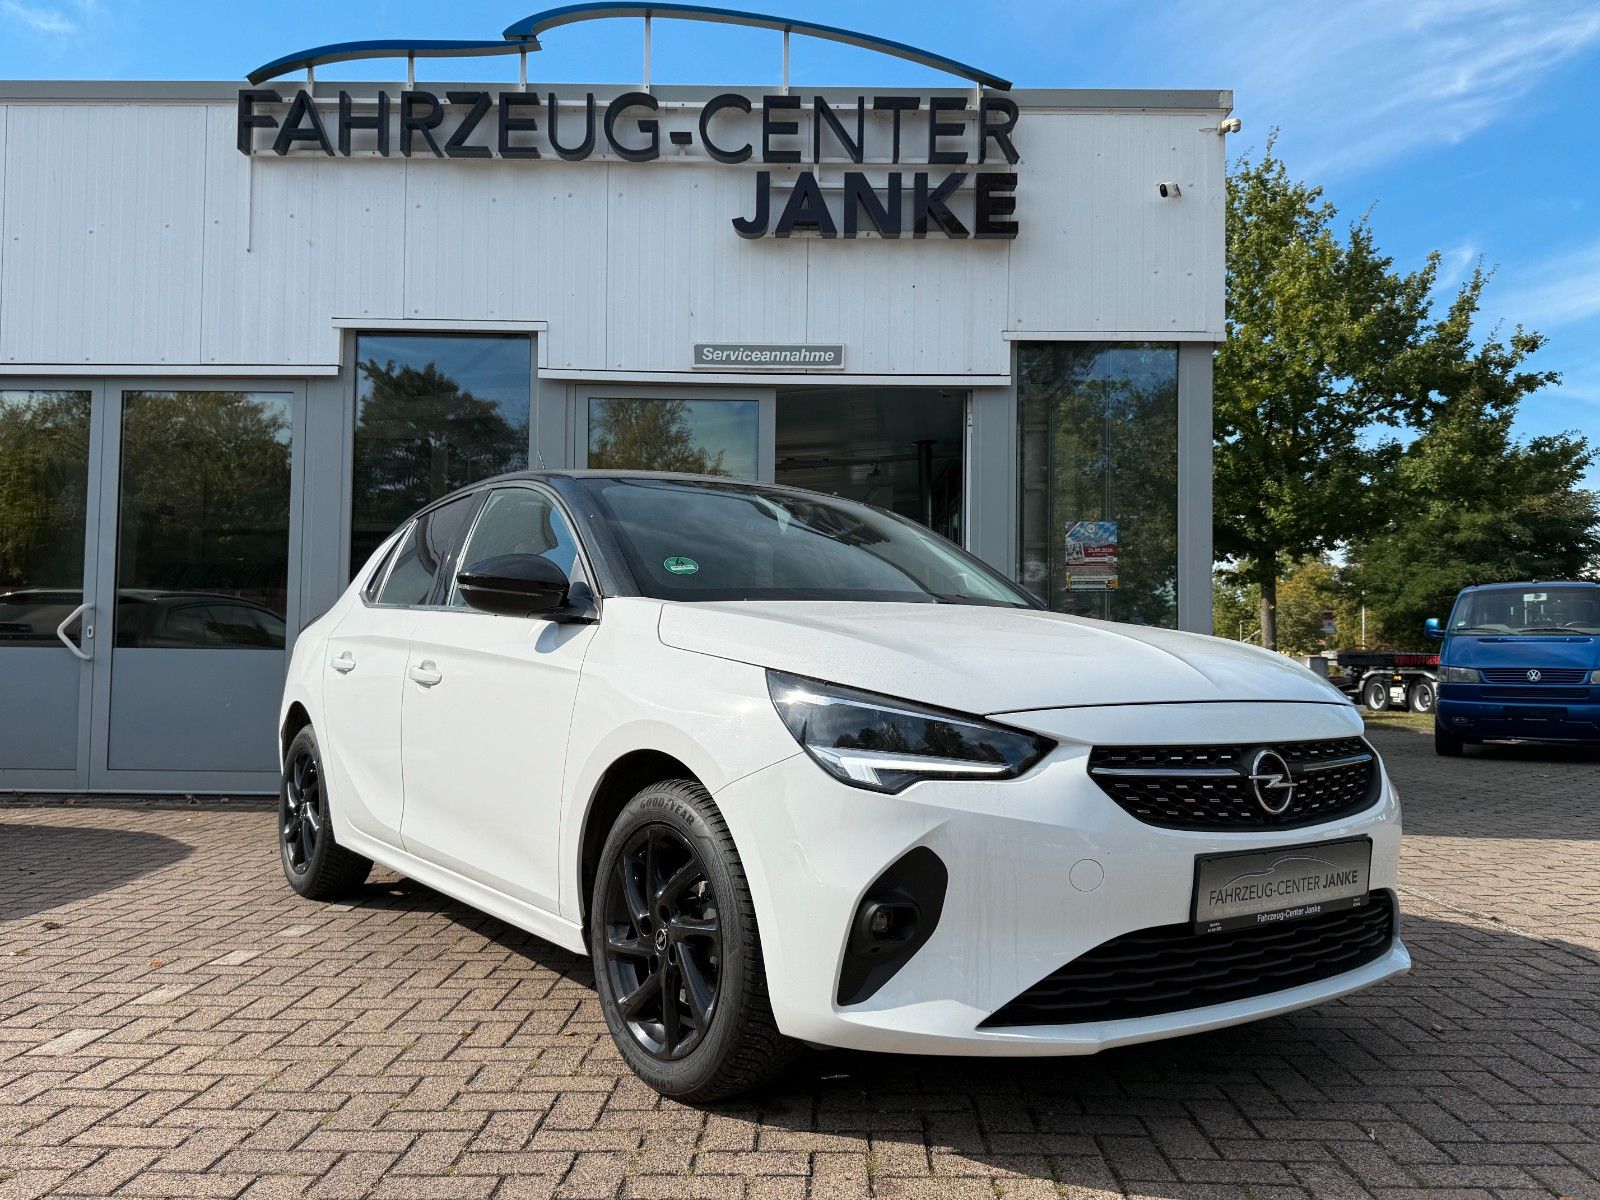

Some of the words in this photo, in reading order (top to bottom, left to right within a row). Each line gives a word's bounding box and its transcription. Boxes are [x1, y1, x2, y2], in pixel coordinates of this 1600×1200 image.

[238, 89, 1020, 165] FAHRZEUG-CENTER
[732, 170, 1020, 240] JANKE
[702, 347, 835, 362] Serviceannahme
[640, 797, 695, 826] GOODYEAR
[1209, 875, 1320, 906] FAHRZEUG-CENTER
[1322, 870, 1358, 889] JANKE
[1257, 907, 1304, 922] Fahrzeug-Center
[1304, 904, 1321, 915] Janke
